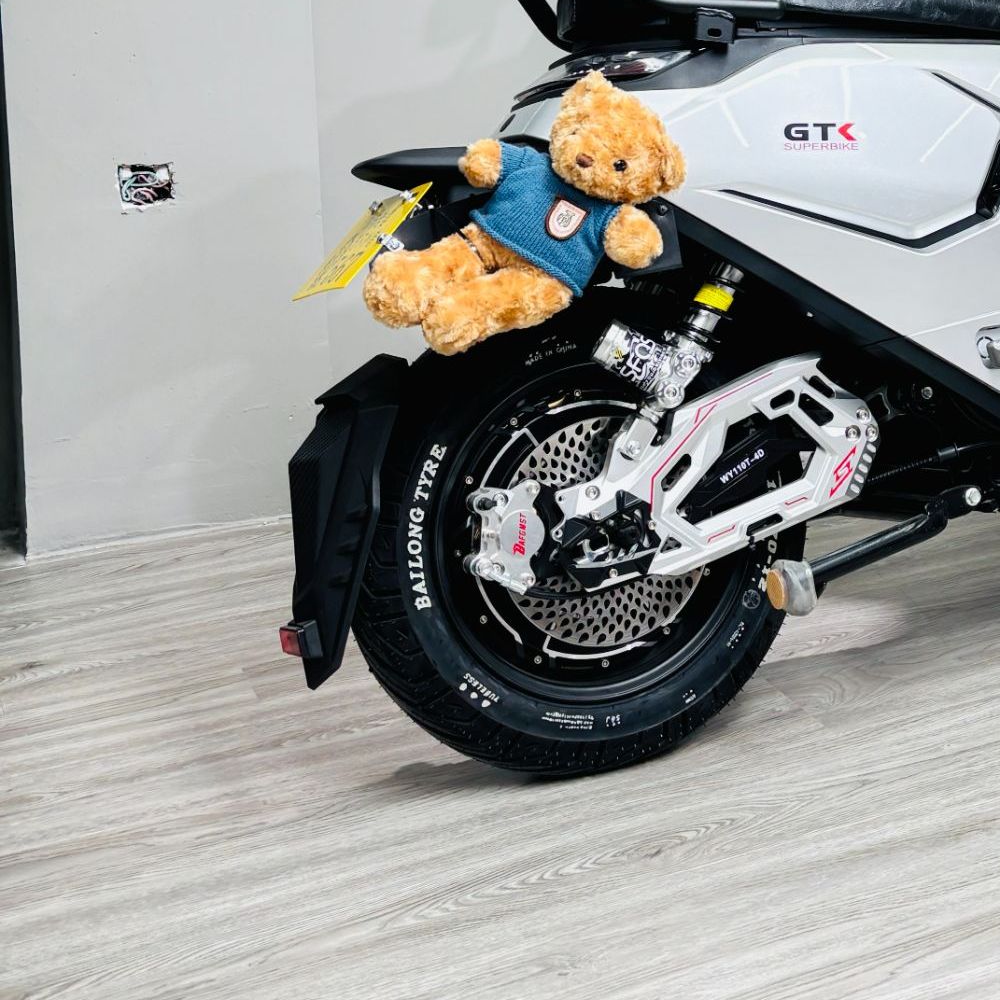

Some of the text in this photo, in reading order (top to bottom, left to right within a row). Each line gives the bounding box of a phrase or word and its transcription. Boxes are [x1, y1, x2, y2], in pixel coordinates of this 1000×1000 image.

[784, 142, 859, 151] SUPERBIKE
[719, 448, 766, 484] WY110T-4D
[407, 443, 448, 611] BAILONG TYRE
